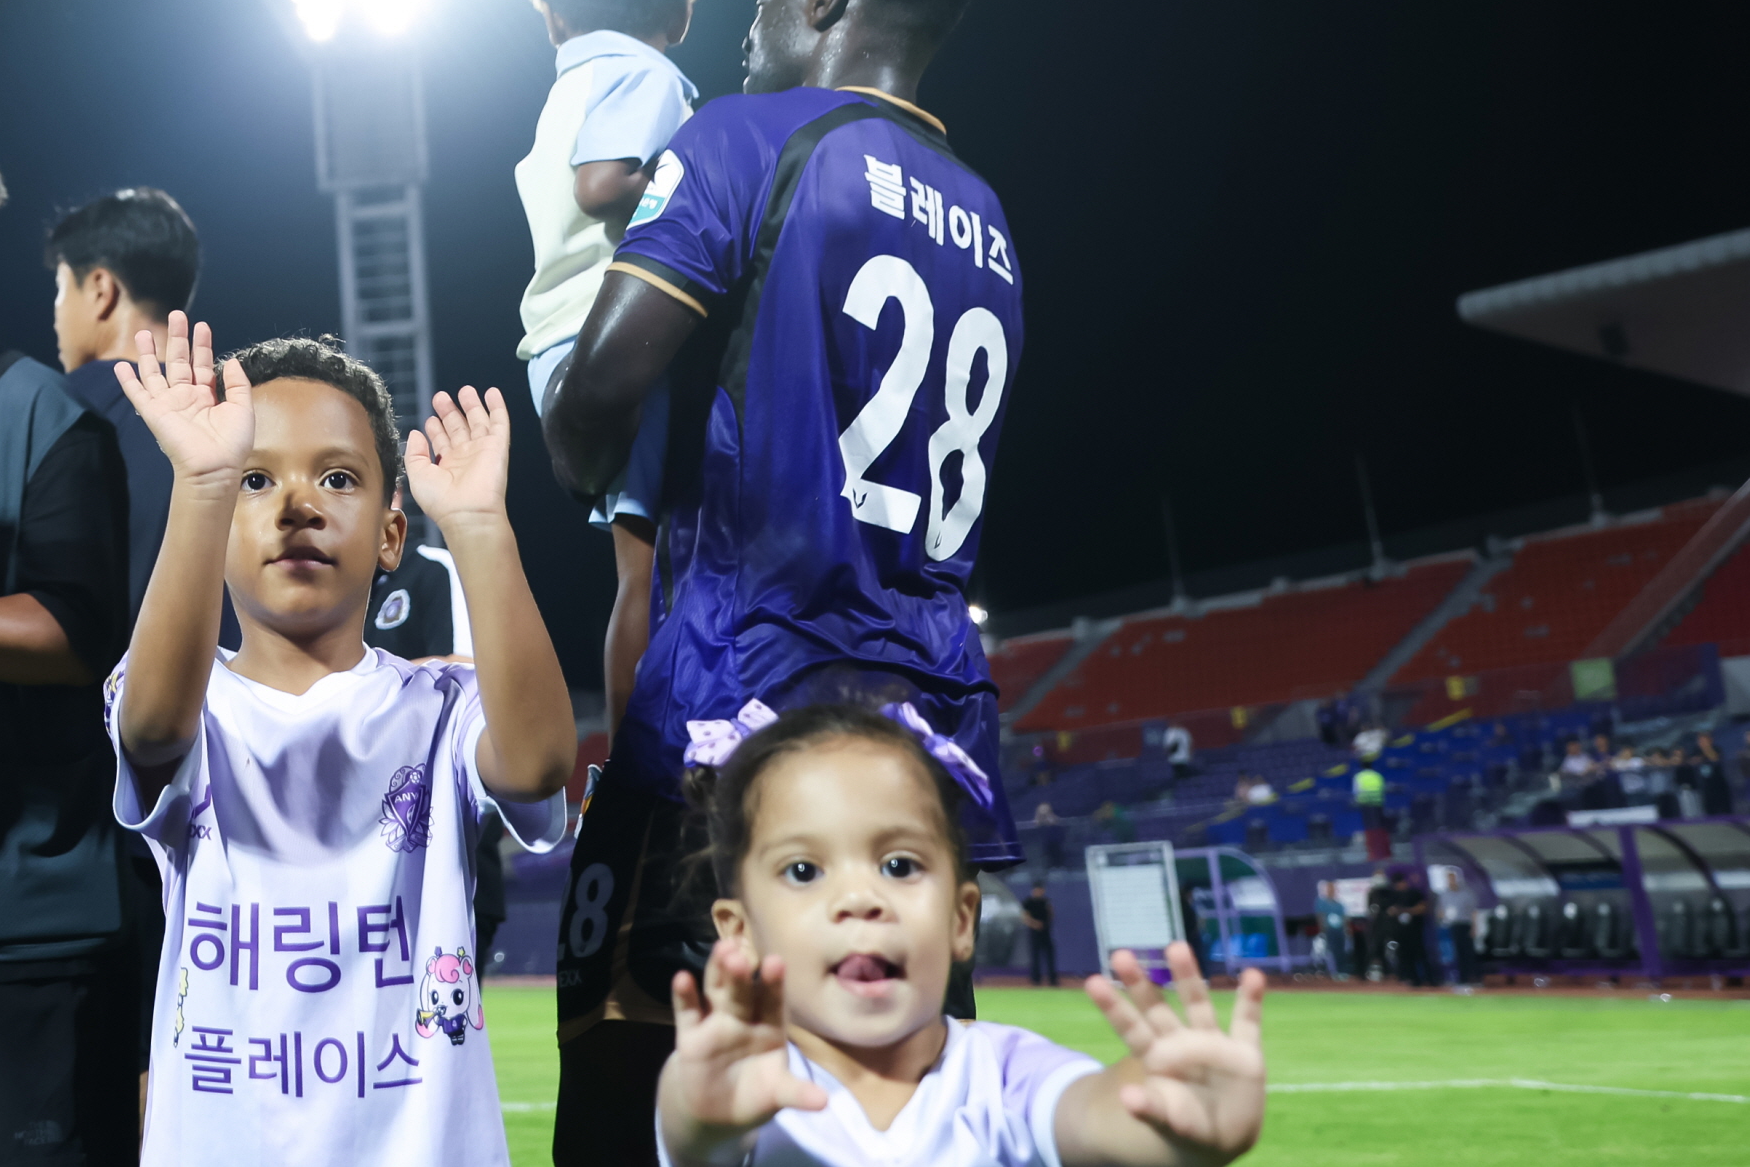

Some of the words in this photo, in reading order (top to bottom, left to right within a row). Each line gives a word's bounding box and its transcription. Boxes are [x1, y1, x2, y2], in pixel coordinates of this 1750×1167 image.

[863, 154, 1014, 286] 블레이즈
[837, 254, 1008, 562] 28
[187, 895, 415, 993] 해링턴
[184, 1025, 423, 1098] 플레이스
